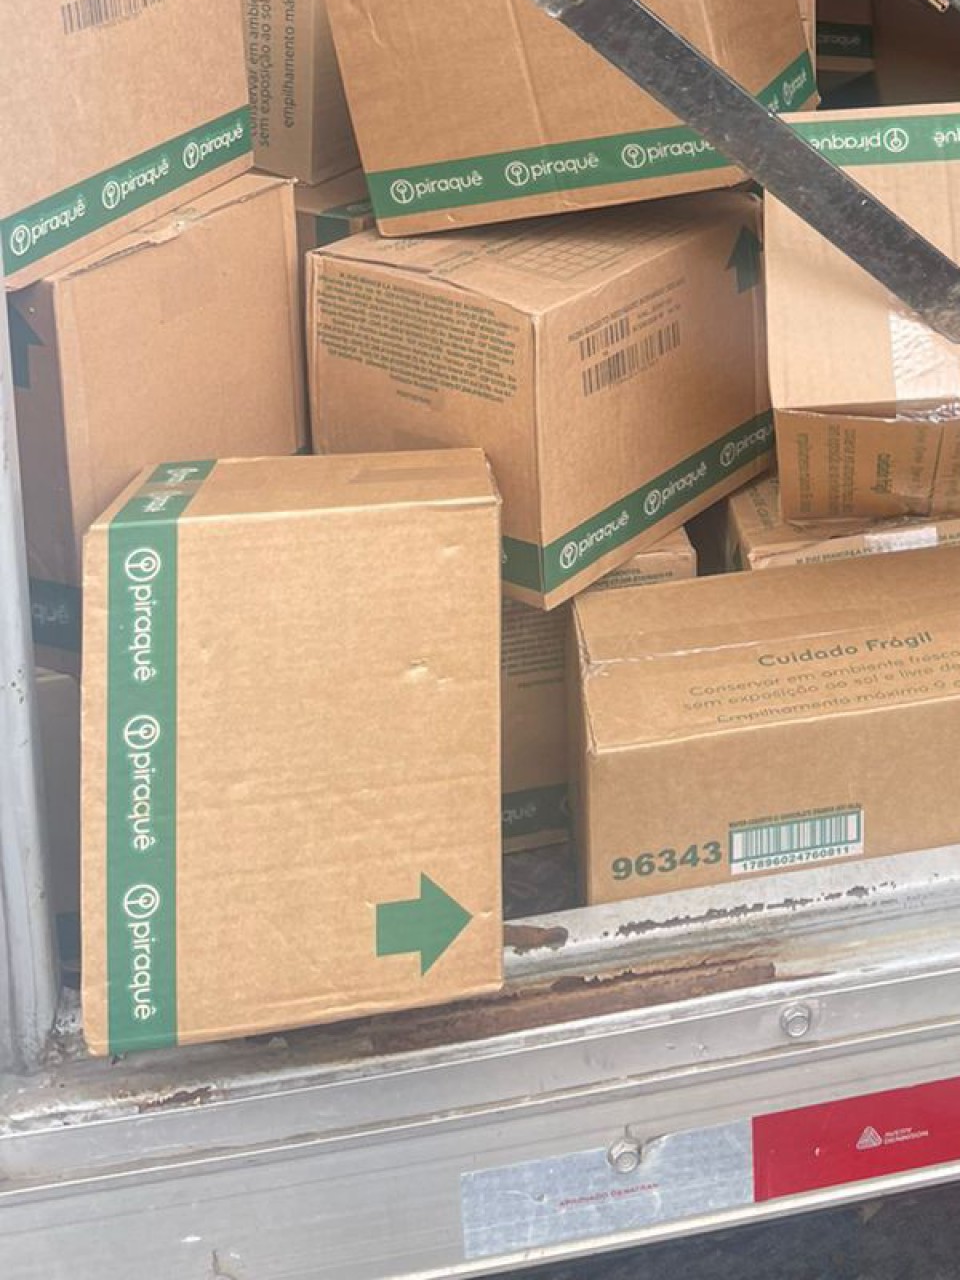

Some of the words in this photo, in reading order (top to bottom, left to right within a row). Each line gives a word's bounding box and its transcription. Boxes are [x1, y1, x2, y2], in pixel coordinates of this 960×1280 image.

[248, 42, 259, 65] em
[260, 23, 271, 41] ao
[259, 44, 273, 115] exposição
[282, 26, 296, 129] empilhamento
[258, 118, 270, 148] sem
[31, 194, 87, 246] piraquê
[119, 157, 170, 201] piraquê
[197, 122, 245, 161] piraquê
[416, 169, 484, 200] piraquê
[530, 151, 601, 181] piraquê
[578, 511, 630, 553] piraquê
[661, 461, 709, 502] piraquê
[733, 425, 773, 455] piraqu
[126, 584, 157, 683] piraquê
[758, 644, 858, 668] Cuidado
[865, 631, 933, 653] Frágil
[683, 697, 722, 711] sem
[727, 683, 819, 705] exposição
[825, 680, 848, 690] ao
[854, 673, 879, 686] sol
[900, 666, 935, 679] livre
[689, 676, 780, 697] Conservar
[786, 672, 816, 684] em
[821, 660, 904, 679] ambiente
[716, 694, 852, 725] Empilhamento
[856, 684, 930, 703] máximo
[126, 751, 157, 852] piraquê
[611, 840, 723, 882] 96343
[126, 922, 157, 1021] piraquê
